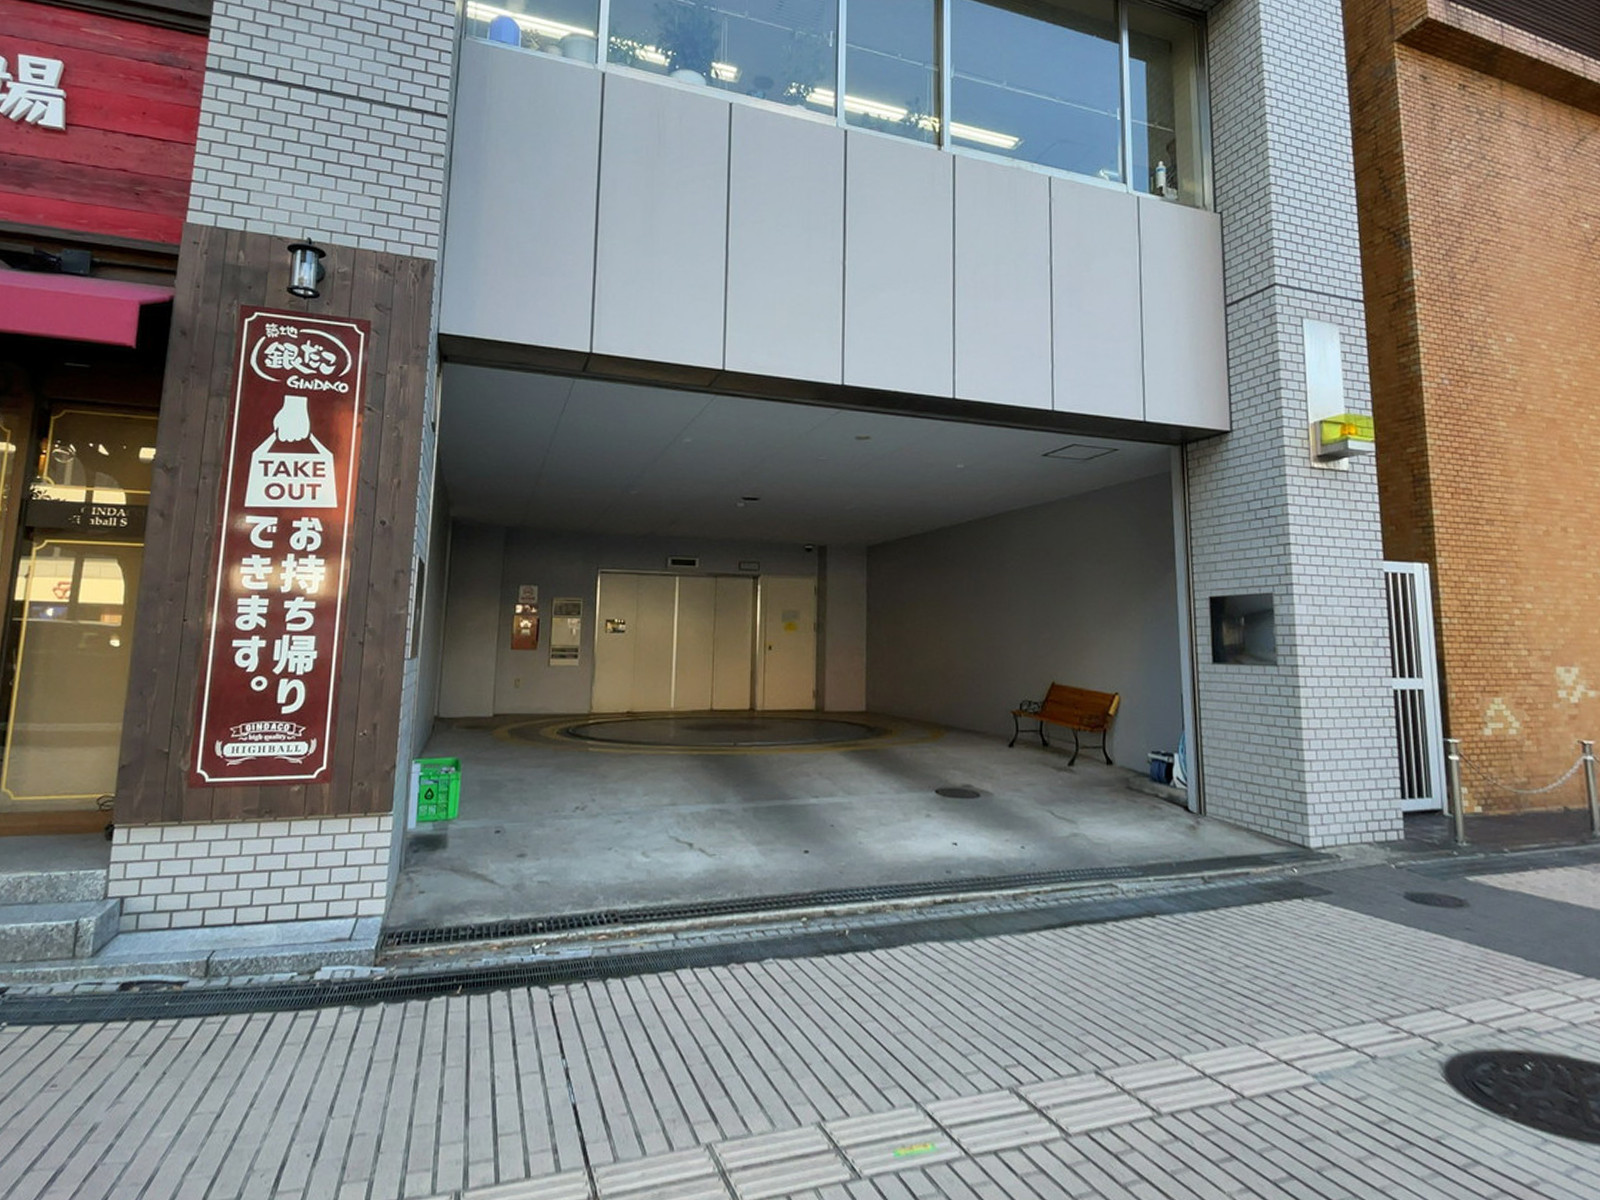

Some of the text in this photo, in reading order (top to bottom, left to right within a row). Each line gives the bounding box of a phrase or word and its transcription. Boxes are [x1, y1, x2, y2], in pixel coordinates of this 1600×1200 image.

[263, 339, 337, 375] 銀だこ
[286, 375, 349, 393] GINDACO
[258, 460, 327, 478] TAKE
[264, 482, 322, 501] OUT
[231, 515, 279, 692] できます。
[272, 516, 327, 715] お持ち帰り
[230, 744, 302, 755] HIGHBALL
